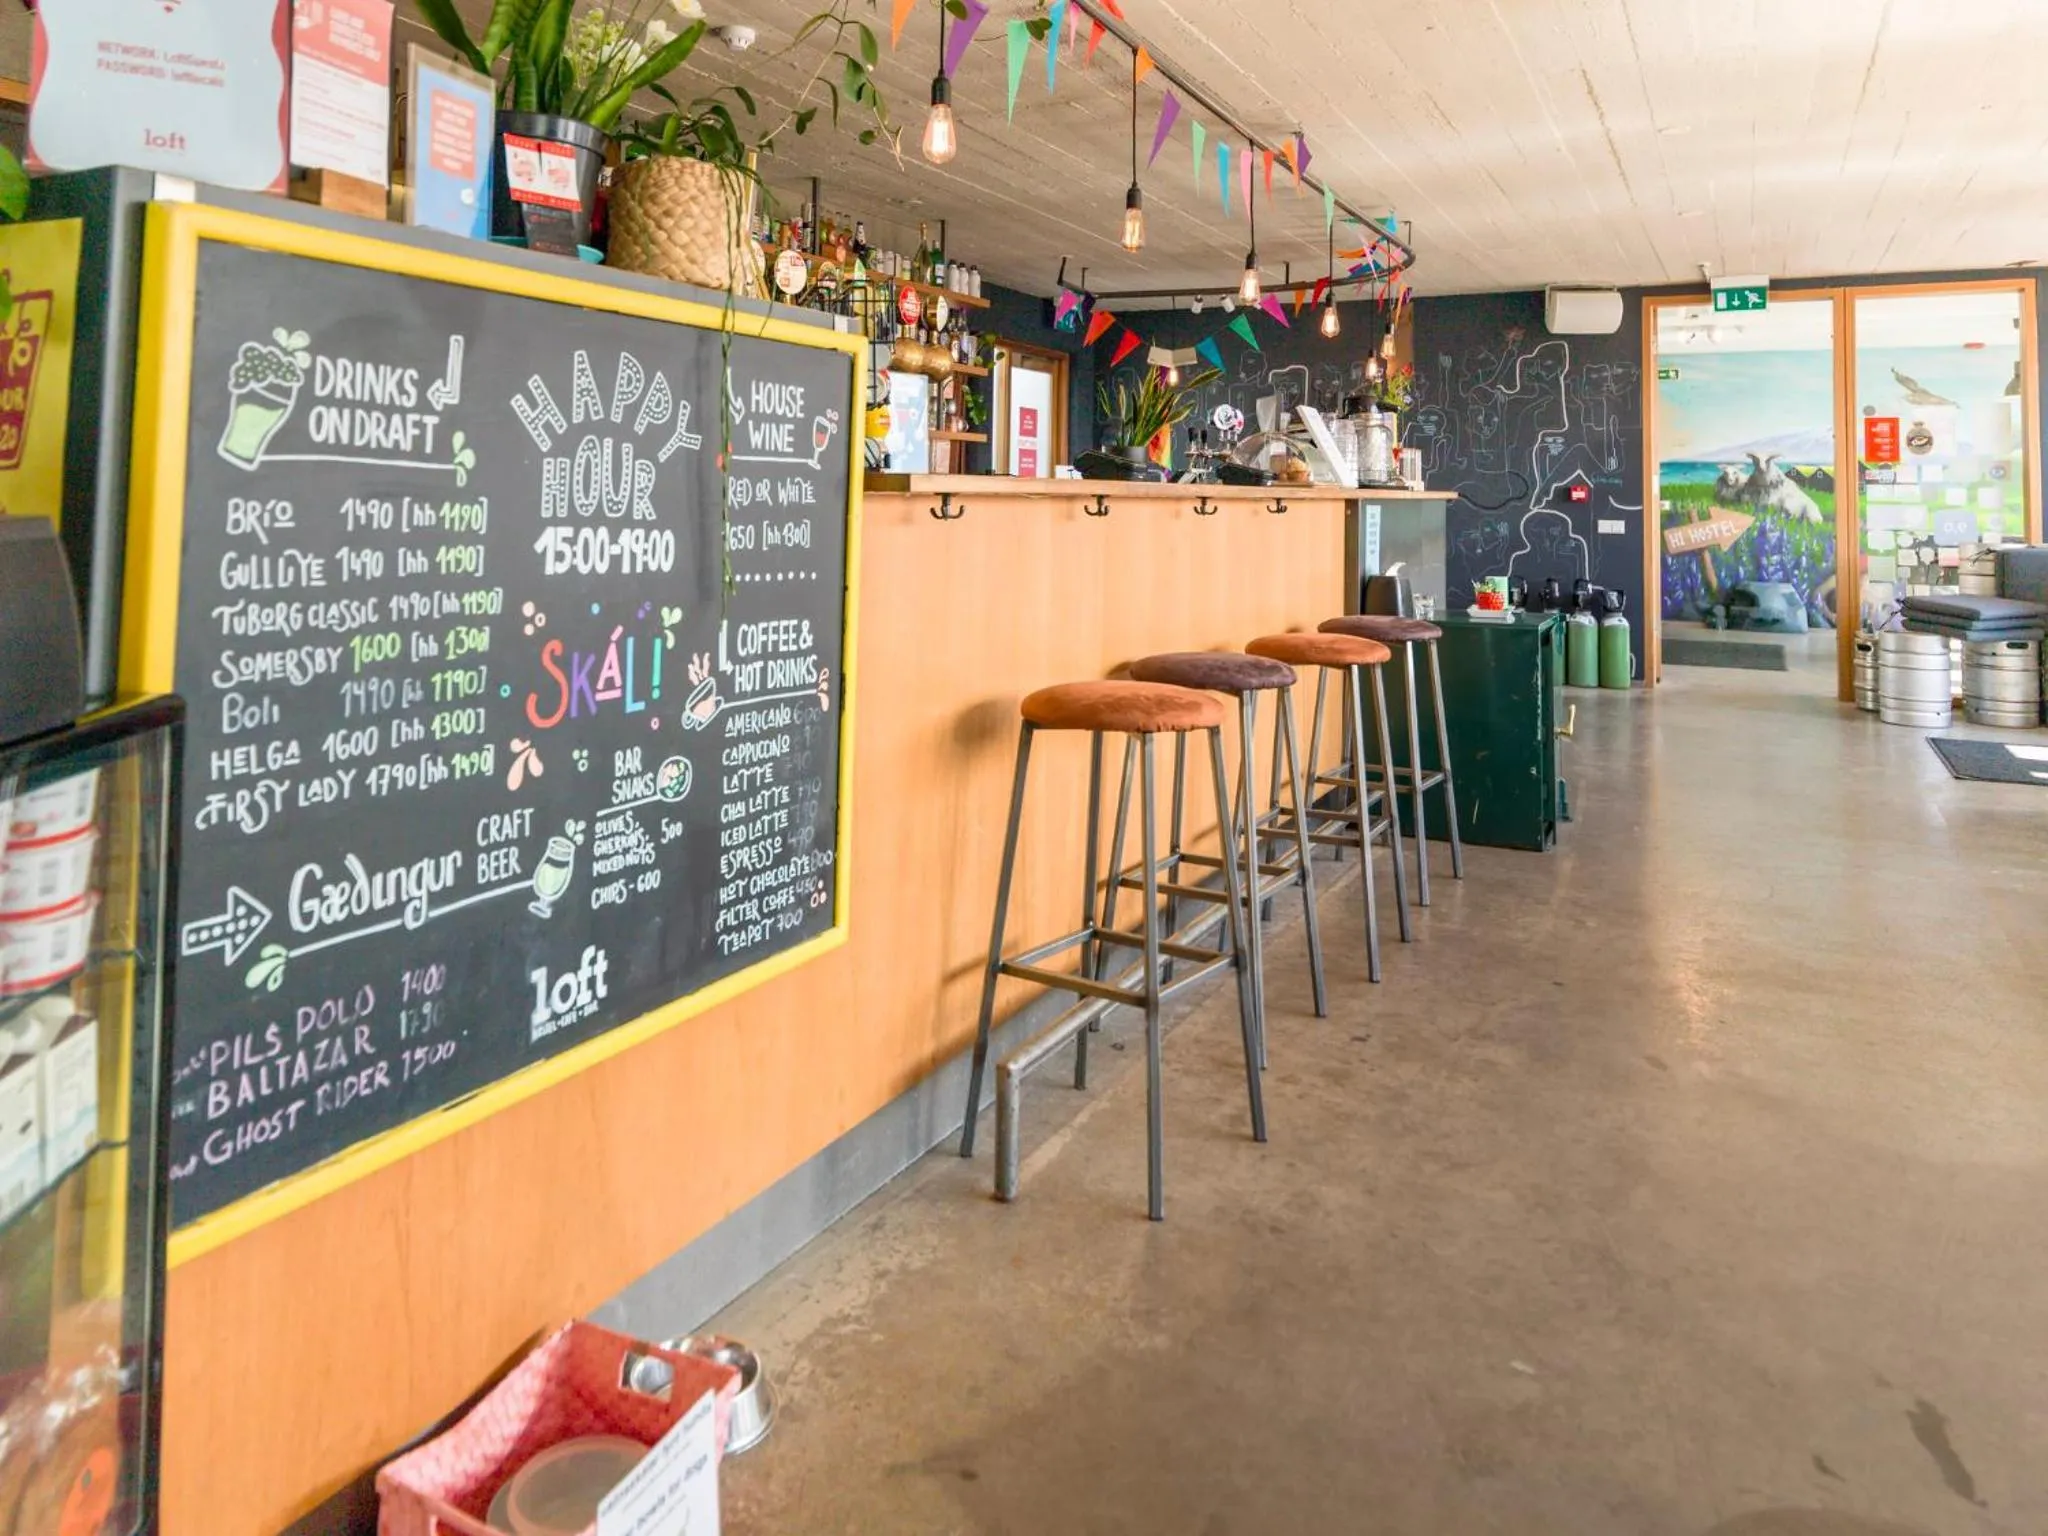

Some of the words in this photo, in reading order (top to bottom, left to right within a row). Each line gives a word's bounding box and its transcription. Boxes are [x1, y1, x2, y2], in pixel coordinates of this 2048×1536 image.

[144, 128, 187, 151] loft
[314, 354, 420, 408] DRINKS
[751, 379, 805, 418] HOUSE
[510, 349, 702, 463] HAPPY
[748, 419, 795, 453] WINE
[541, 434, 657, 521] HOUR
[728, 476, 752, 510] RED
[755, 478, 774, 506] OR
[777, 477, 817, 507] WHITE
[339, 497, 393, 532] 1490
[1667, 530, 1686, 549] HI
[1689, 520, 1742, 545] HOSTEL
[335, 546, 384, 582] 1490
[533, 526, 676, 576] 15:00-19:00
[211, 598, 303, 637] TUBORG
[307, 597, 379, 633] CLASSIC
[388, 591, 430, 622] 1490
[736, 619, 798, 657] COFFEE
[211, 645, 343, 689] SOMERSBY
[350, 631, 402, 673] 1600
[526, 624, 663, 729] SKÁL!
[734, 660, 764, 694] HOT
[767, 654, 818, 690] DRINKS
[339, 677, 396, 719] 1490
[725, 702, 792, 738] AMERICANO
[210, 739, 302, 781] HELGA
[321, 725, 379, 764] 1600
[614, 746, 642, 777] BAR
[722, 733, 791, 766] CAPPUCCINO
[297, 767, 357, 807] LADY
[366, 763, 417, 797] 1790
[723, 762, 774, 794] LATTE
[720, 800, 746, 824] CHAI
[749, 786, 790, 813] LATTE
[476, 808, 535, 847] CRAFT
[661, 816, 683, 844] 500
[720, 824, 747, 848] ICED
[749, 809, 789, 839] LATTE
[476, 846, 522, 884] BEER
[720, 836, 783, 880] ESPRESSO
[591, 878, 627, 910] CHIPS
[636, 868, 661, 893] 600
[719, 876, 748, 905] HOT
[749, 854, 811, 896] CHOCOLATE
[715, 897, 761, 933] FILTER
[717, 916, 776, 957] TEAPOT
[529, 945, 610, 1026] loft
[210, 1022, 283, 1076] PILS
[296, 984, 375, 1044] POLO
[207, 1024, 376, 1121] BALTAZAR
[203, 1099, 306, 1166] GHOST
[316, 1059, 391, 1116] RIDER
[402, 1040, 457, 1082] 1500
